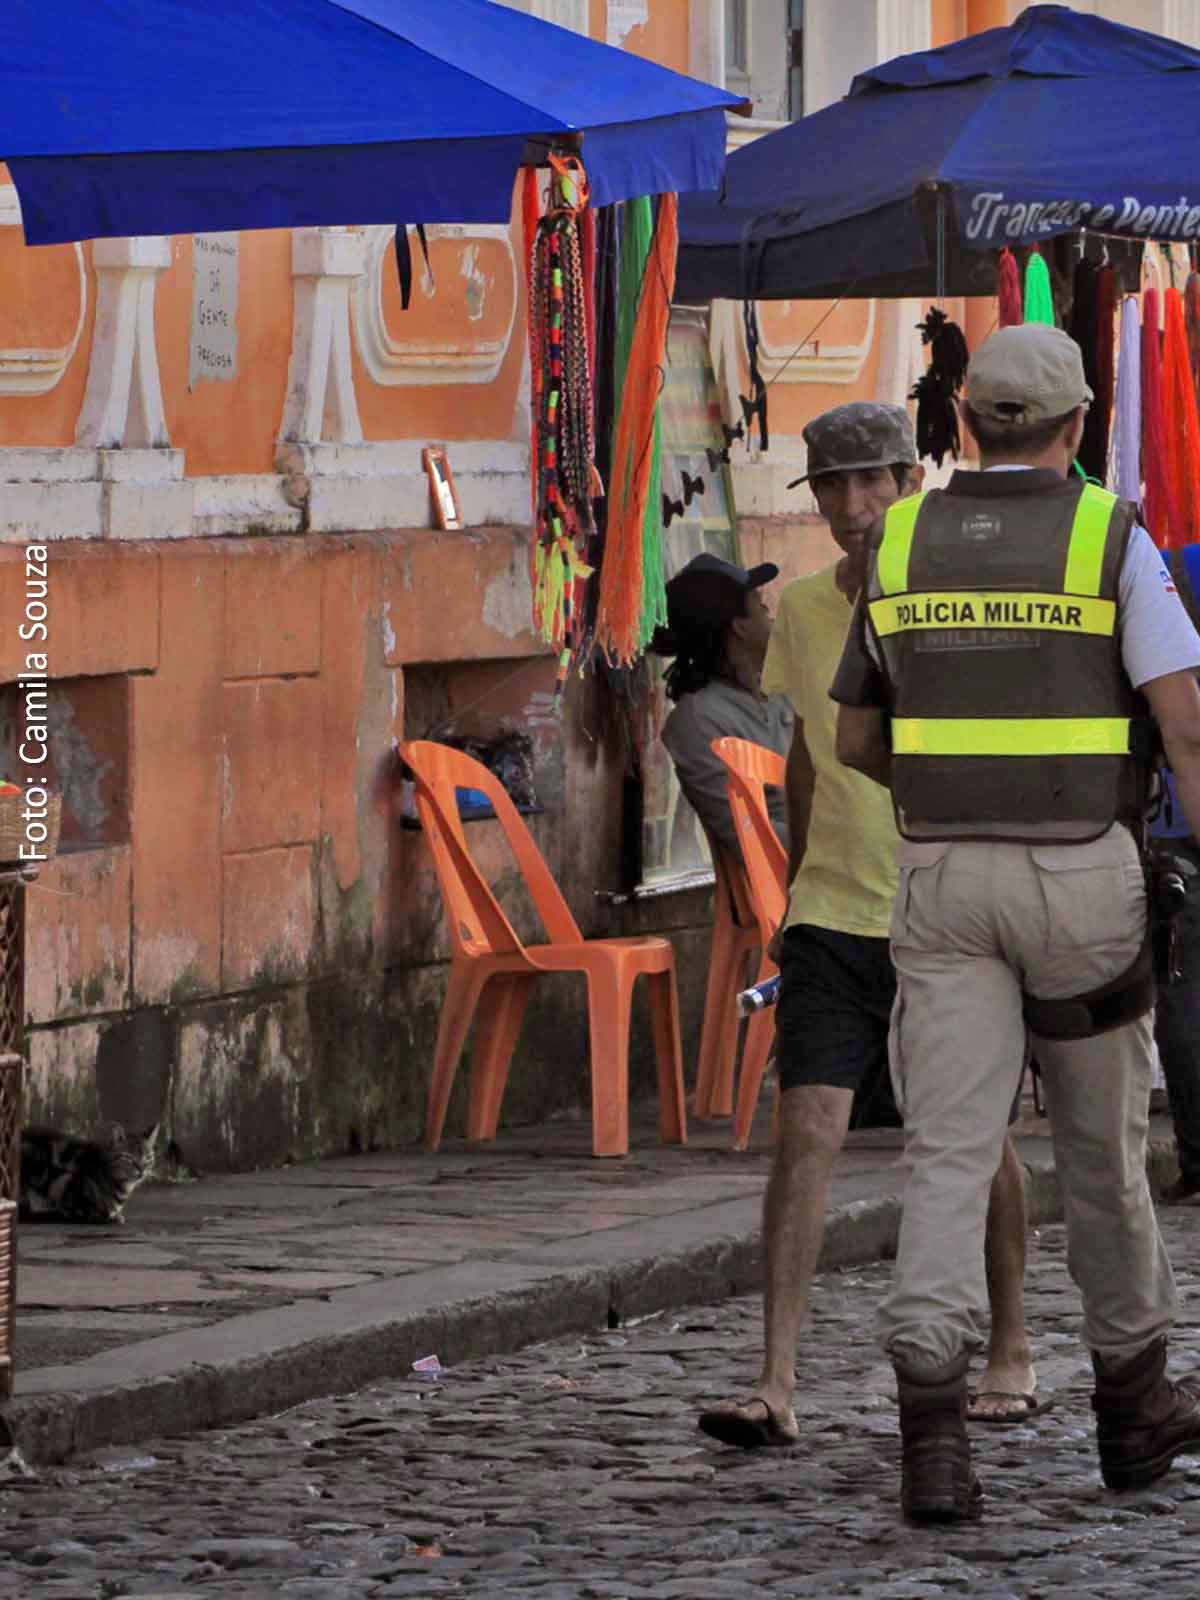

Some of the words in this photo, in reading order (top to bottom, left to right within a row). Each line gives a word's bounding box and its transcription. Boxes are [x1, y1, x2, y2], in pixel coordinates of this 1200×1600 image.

[1094, 203, 1115, 226] e
[897, 597, 976, 626] POLÍCIA
[983, 602, 1083, 627] MILITAR
